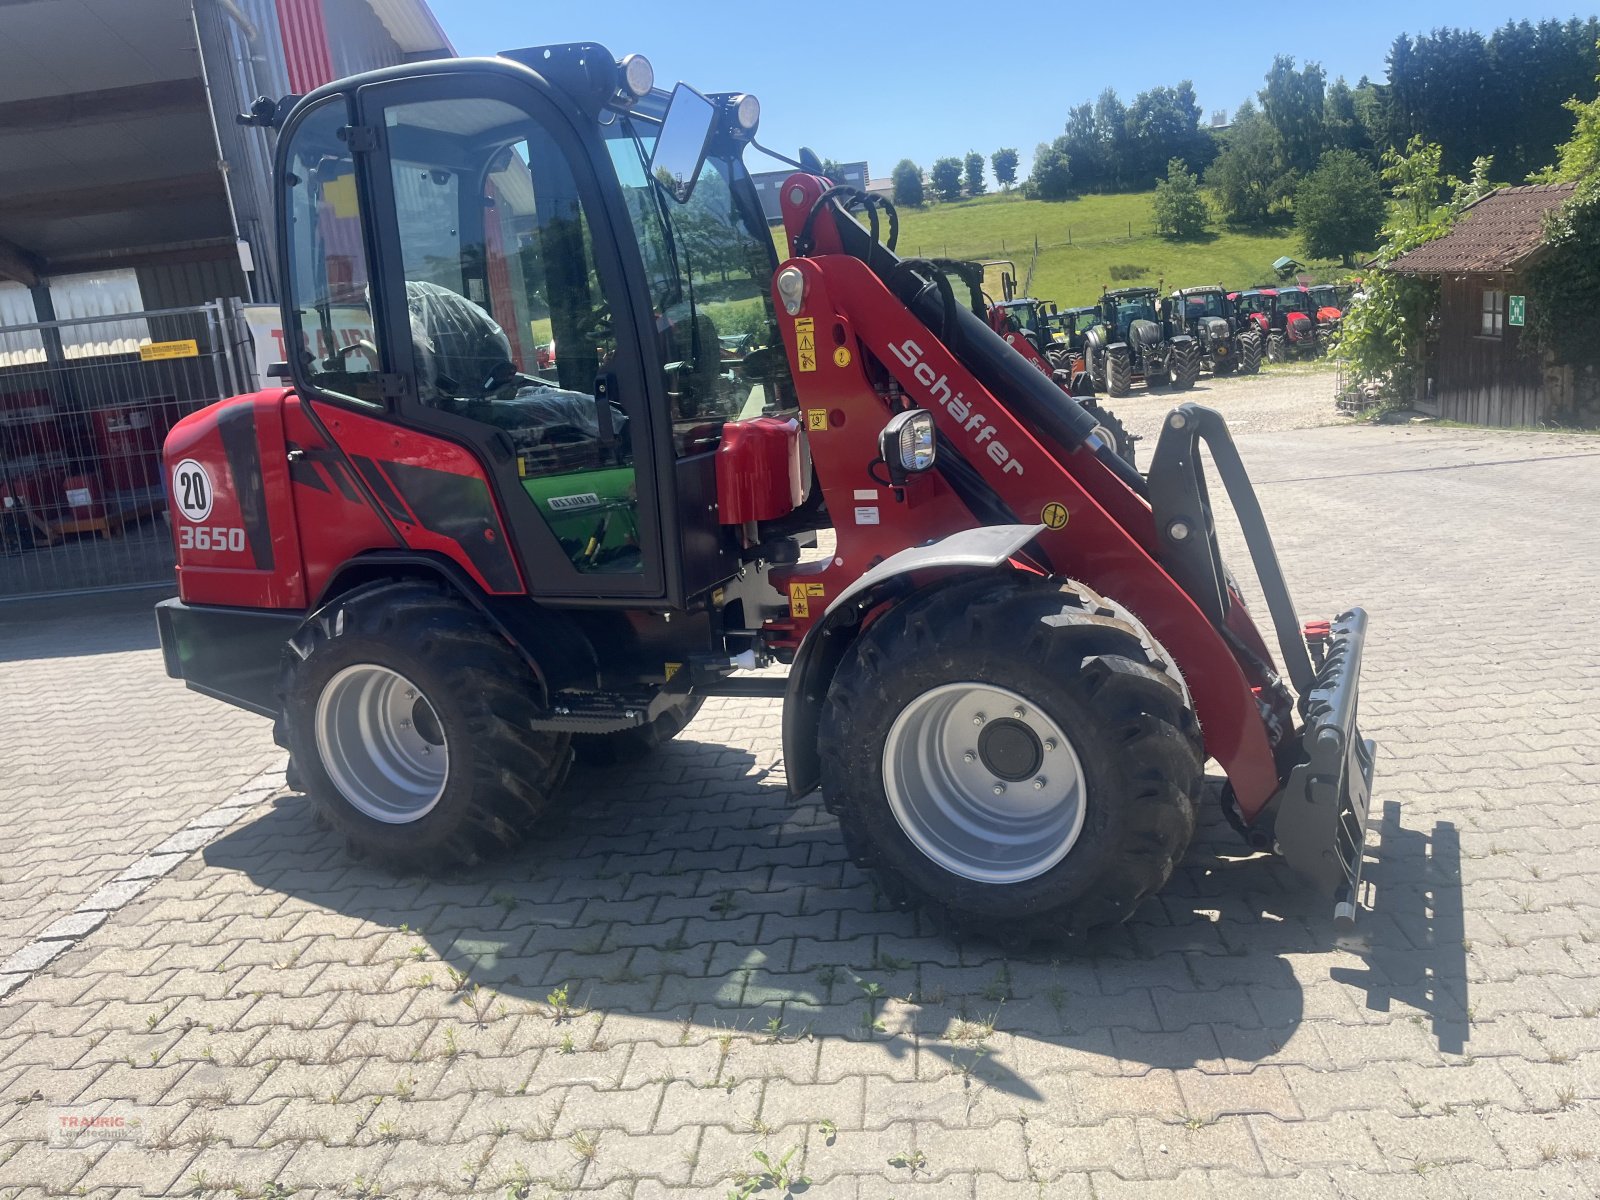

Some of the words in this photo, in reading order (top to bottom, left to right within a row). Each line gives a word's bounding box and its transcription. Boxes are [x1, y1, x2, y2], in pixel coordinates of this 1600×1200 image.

[888, 339, 1024, 476] Schäffer
[180, 471, 207, 510] 20
[179, 525, 246, 552] 3650
